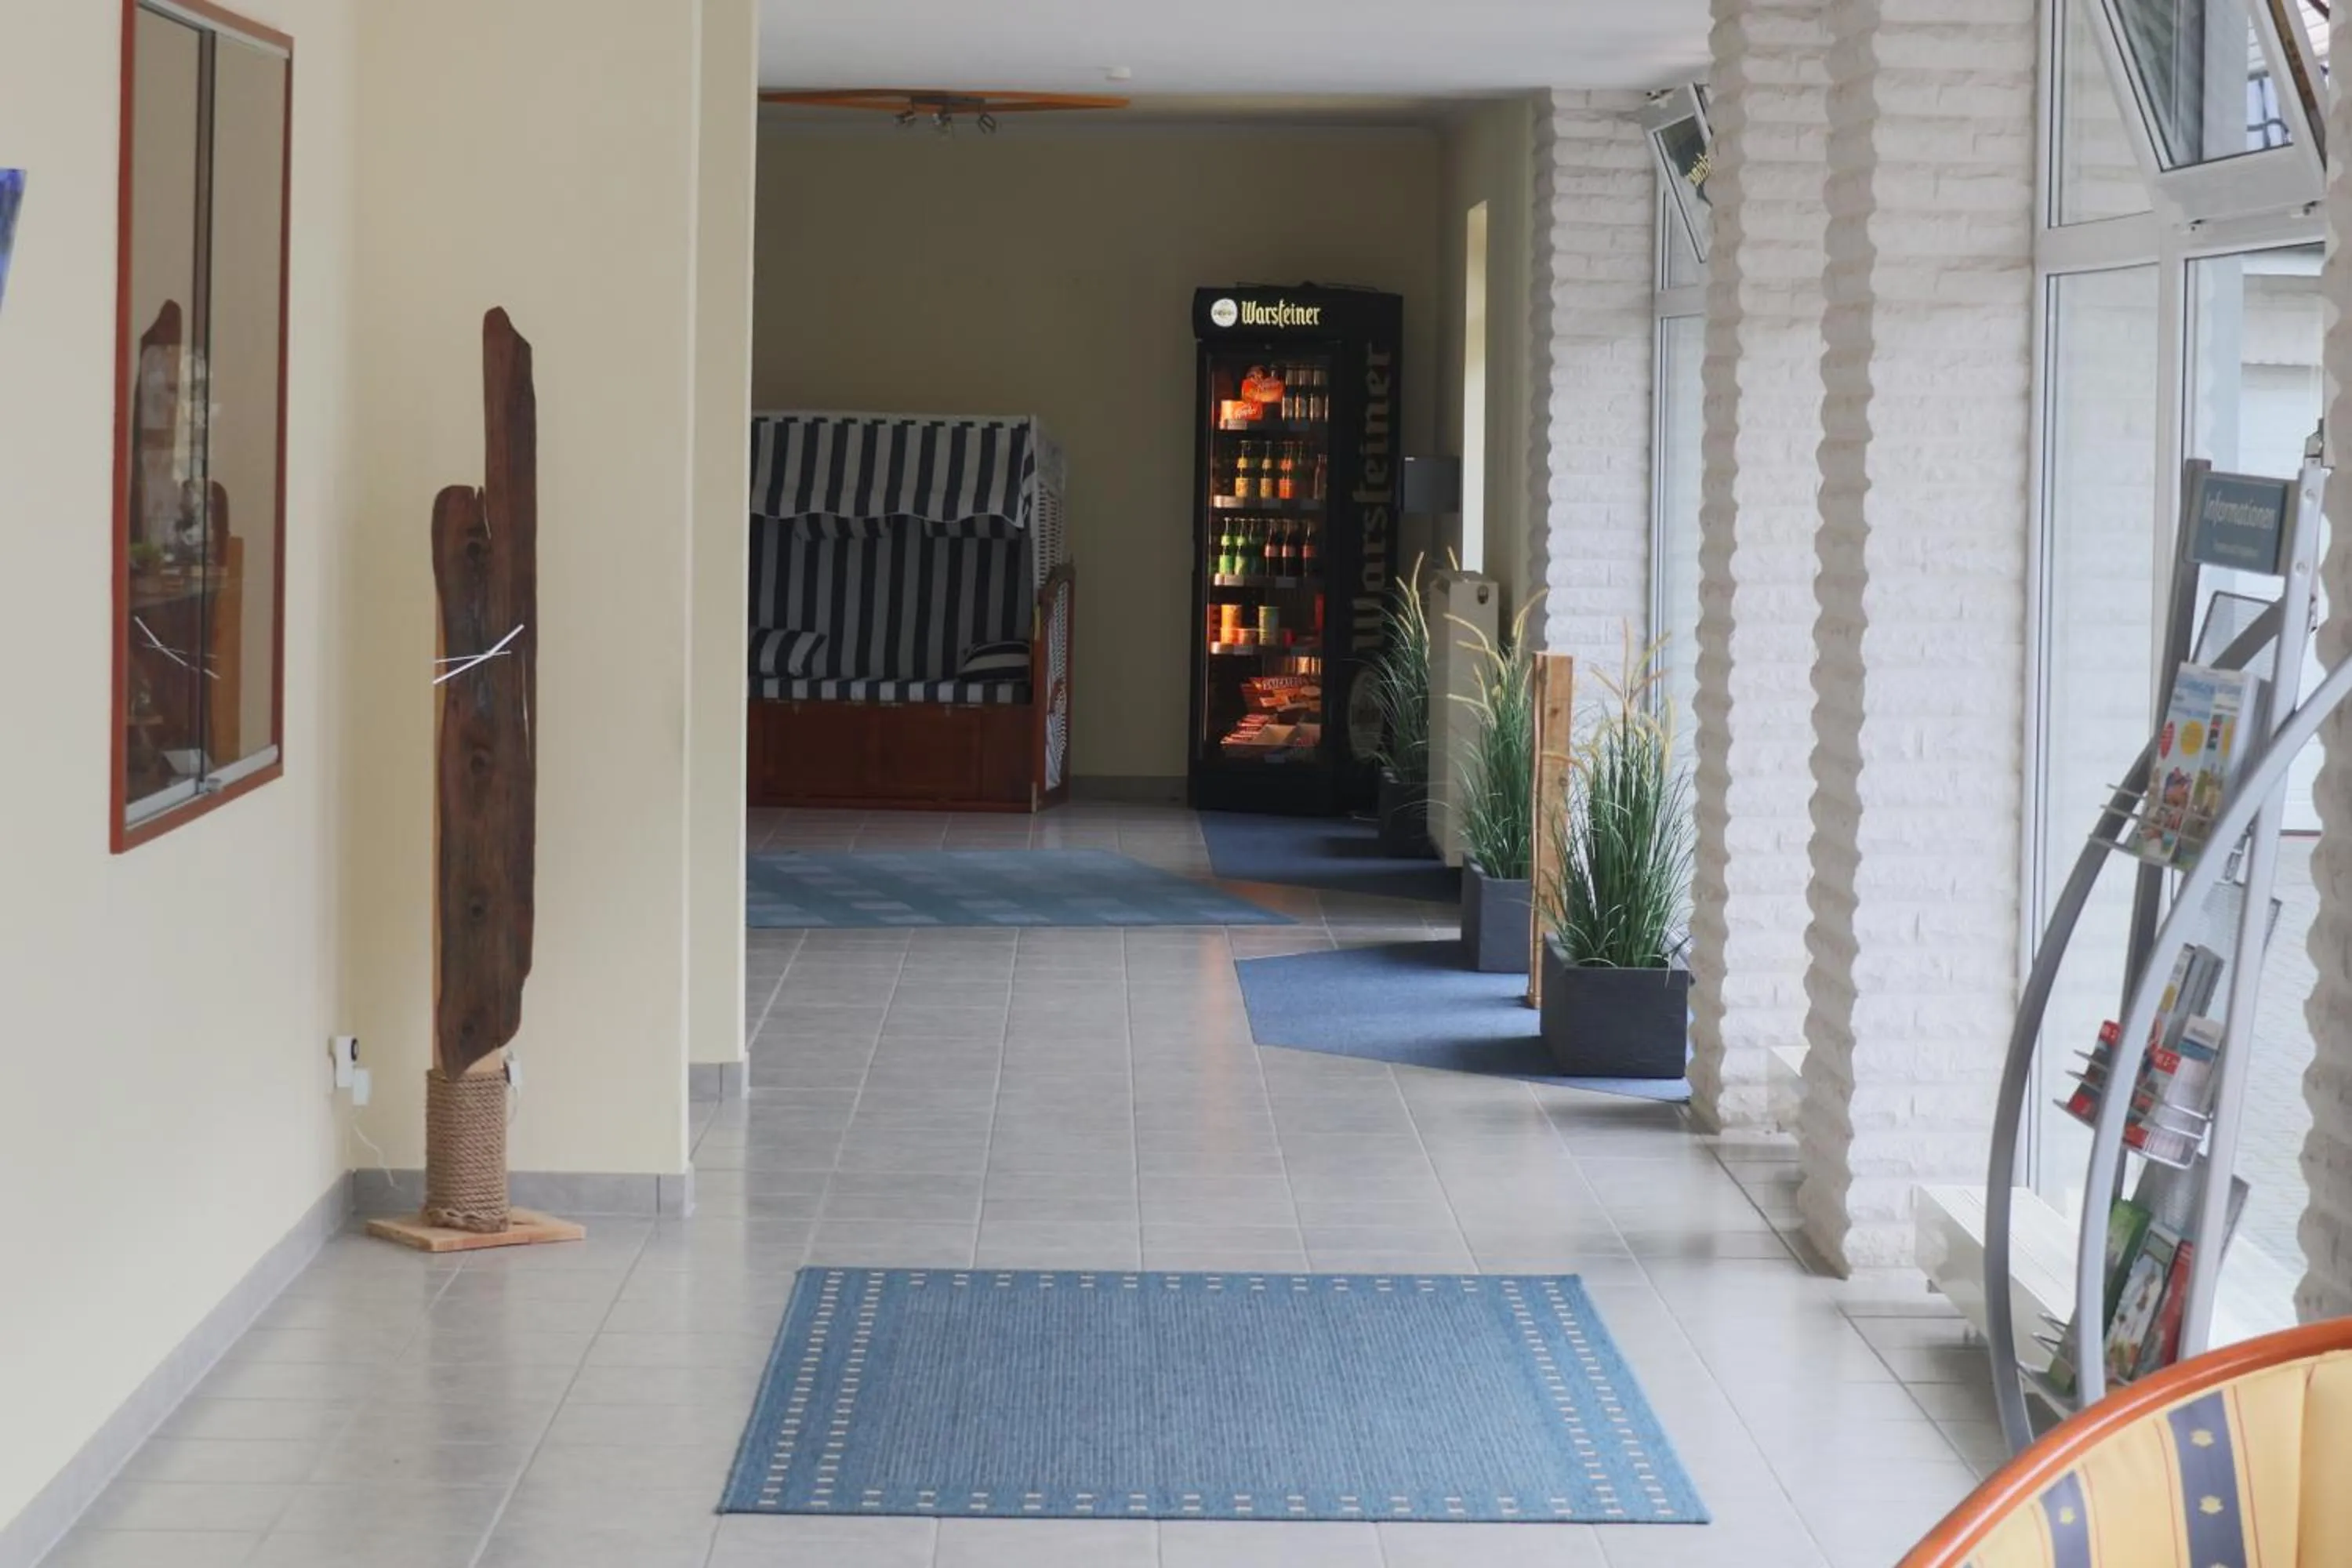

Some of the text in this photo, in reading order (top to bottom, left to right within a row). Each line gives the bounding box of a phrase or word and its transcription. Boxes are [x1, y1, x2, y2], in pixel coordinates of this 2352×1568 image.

[1241, 298, 1321, 328] Warsteiner
[1352, 340, 1392, 652] Warsteiner
[2204, 488, 2277, 532] Informationen
